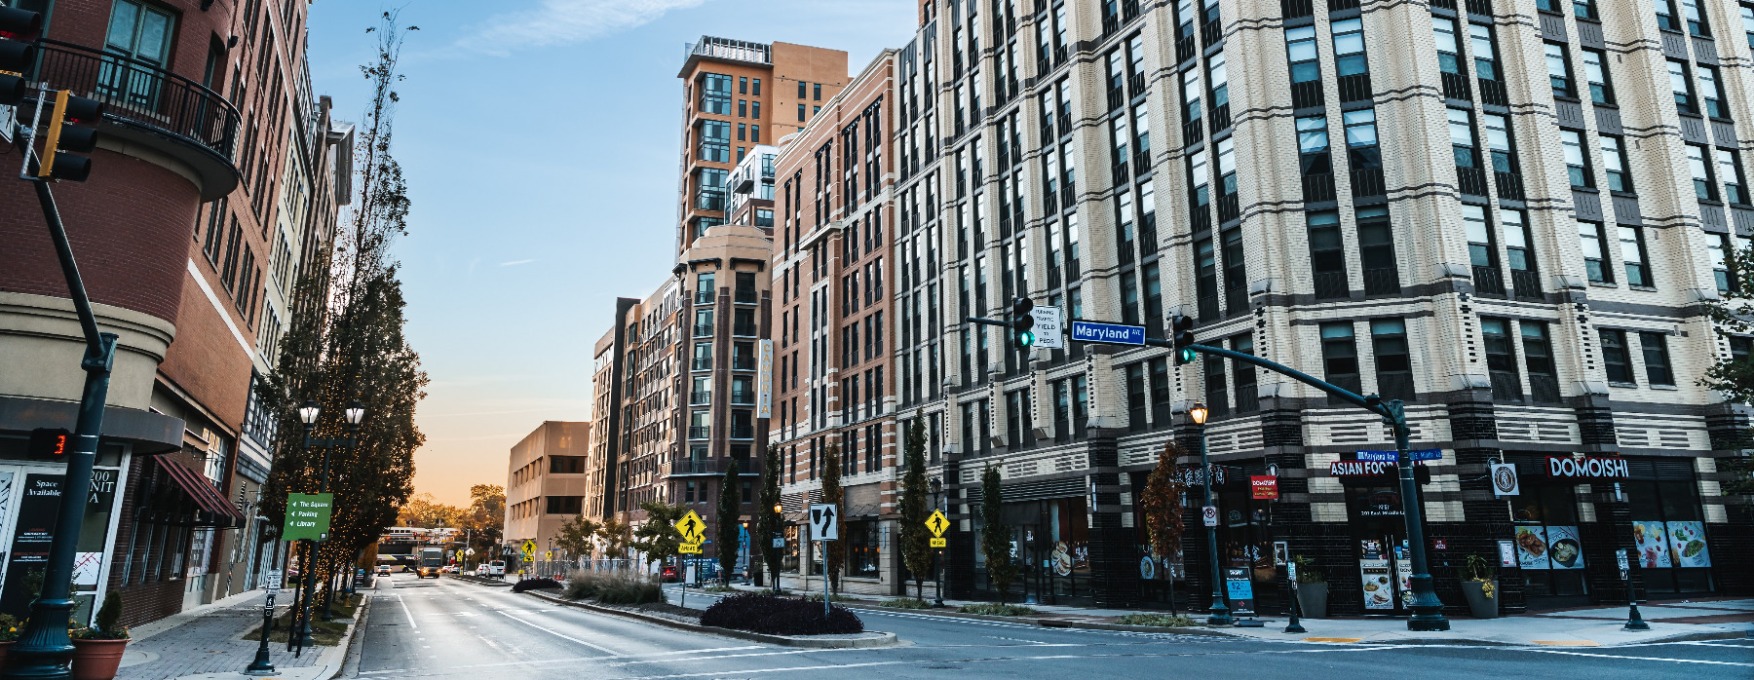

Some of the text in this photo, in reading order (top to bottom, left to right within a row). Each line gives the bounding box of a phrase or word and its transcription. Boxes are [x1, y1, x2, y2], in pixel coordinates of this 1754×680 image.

[1076, 325, 1129, 340] Maryland
[761, 344, 770, 413] CAMBRIA
[54, 435, 66, 454] 3
[1331, 461, 1363, 476] ASIAN
[1364, 461, 1394, 475] FOO
[1550, 457, 1629, 478] DOMOISHI
[36, 480, 59, 488] Space
[90, 480, 115, 492] NIT
[27, 488, 62, 497] Available
[89, 493, 99, 503] A
